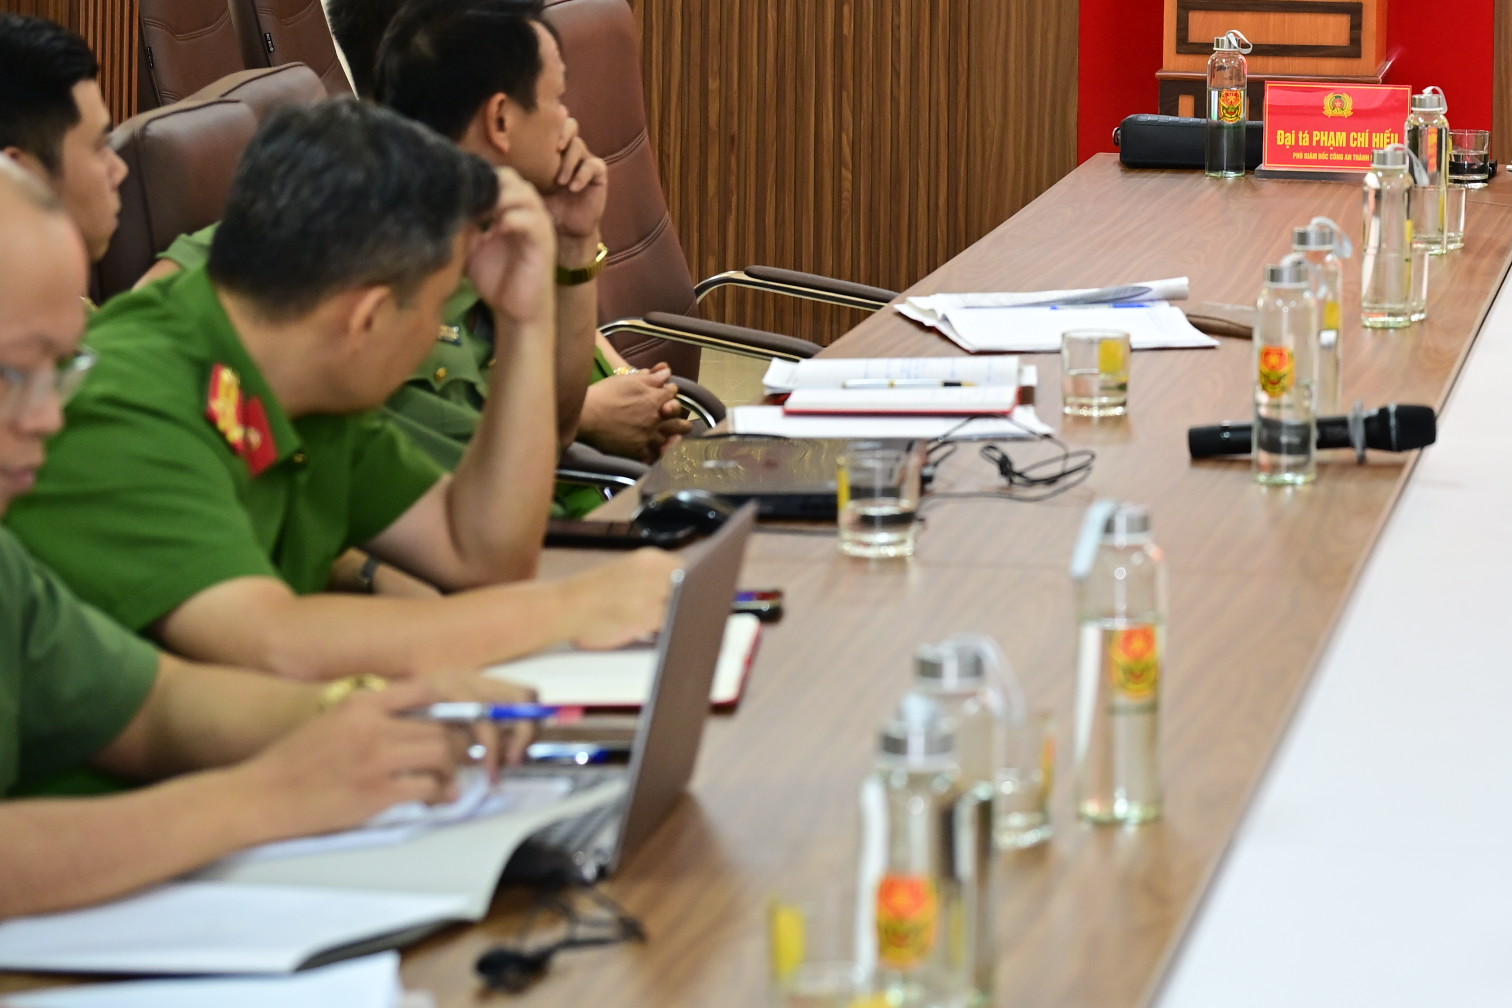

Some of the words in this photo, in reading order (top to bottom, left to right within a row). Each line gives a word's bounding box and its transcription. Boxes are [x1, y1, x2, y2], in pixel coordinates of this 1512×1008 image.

[1276, 129, 1295, 148] Đại
[1298, 130, 1310, 146] tá
[1313, 131, 1347, 150] PHẠM
[1350, 129, 1369, 148] CHÍ
